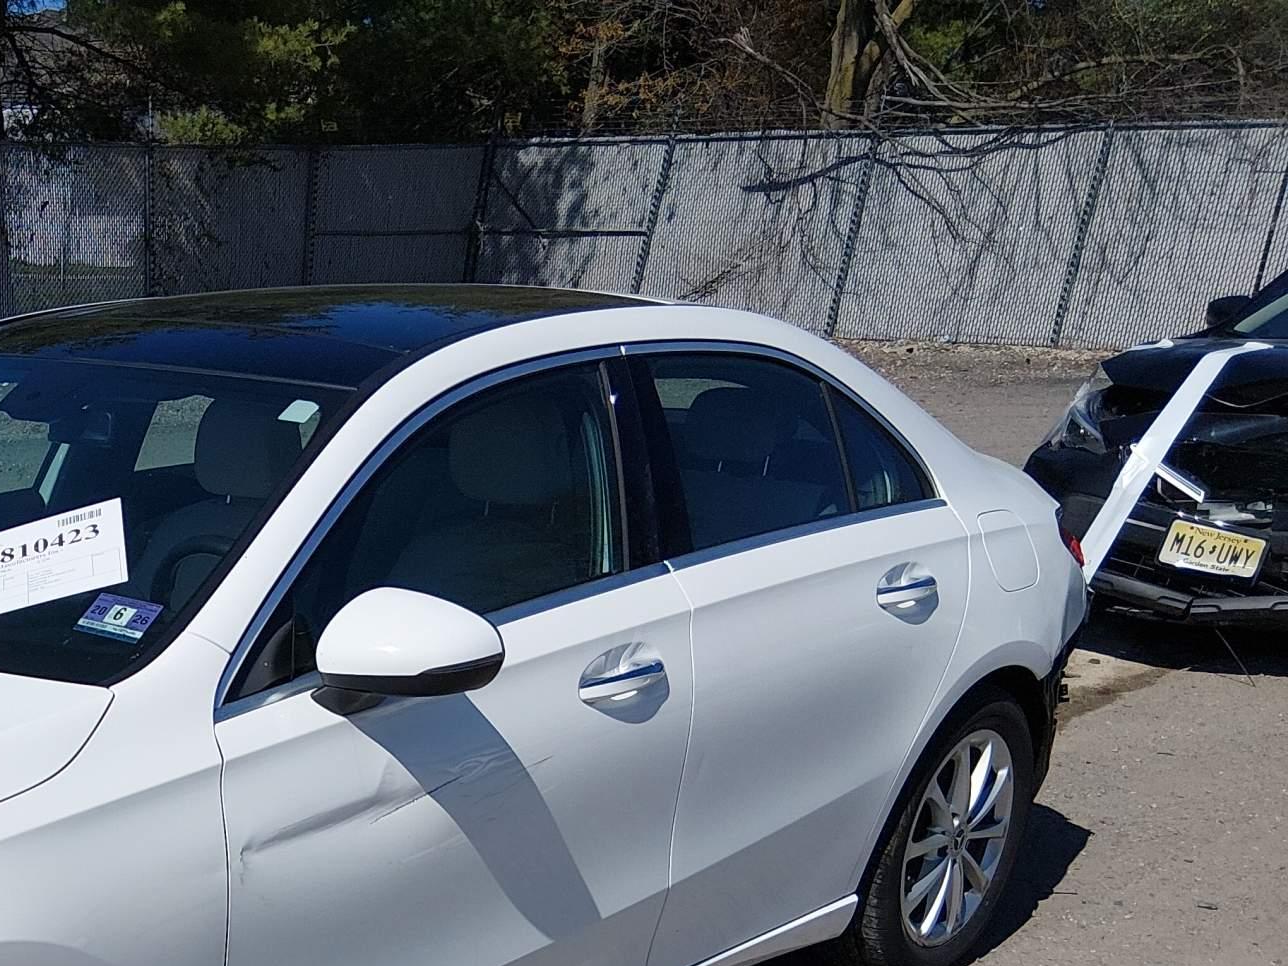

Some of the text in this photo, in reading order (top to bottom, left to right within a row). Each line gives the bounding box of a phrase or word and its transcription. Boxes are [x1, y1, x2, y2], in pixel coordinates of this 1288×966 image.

[1195, 527, 1243, 544] New Jersey
[90, 605, 151, 625] 20 6 26
